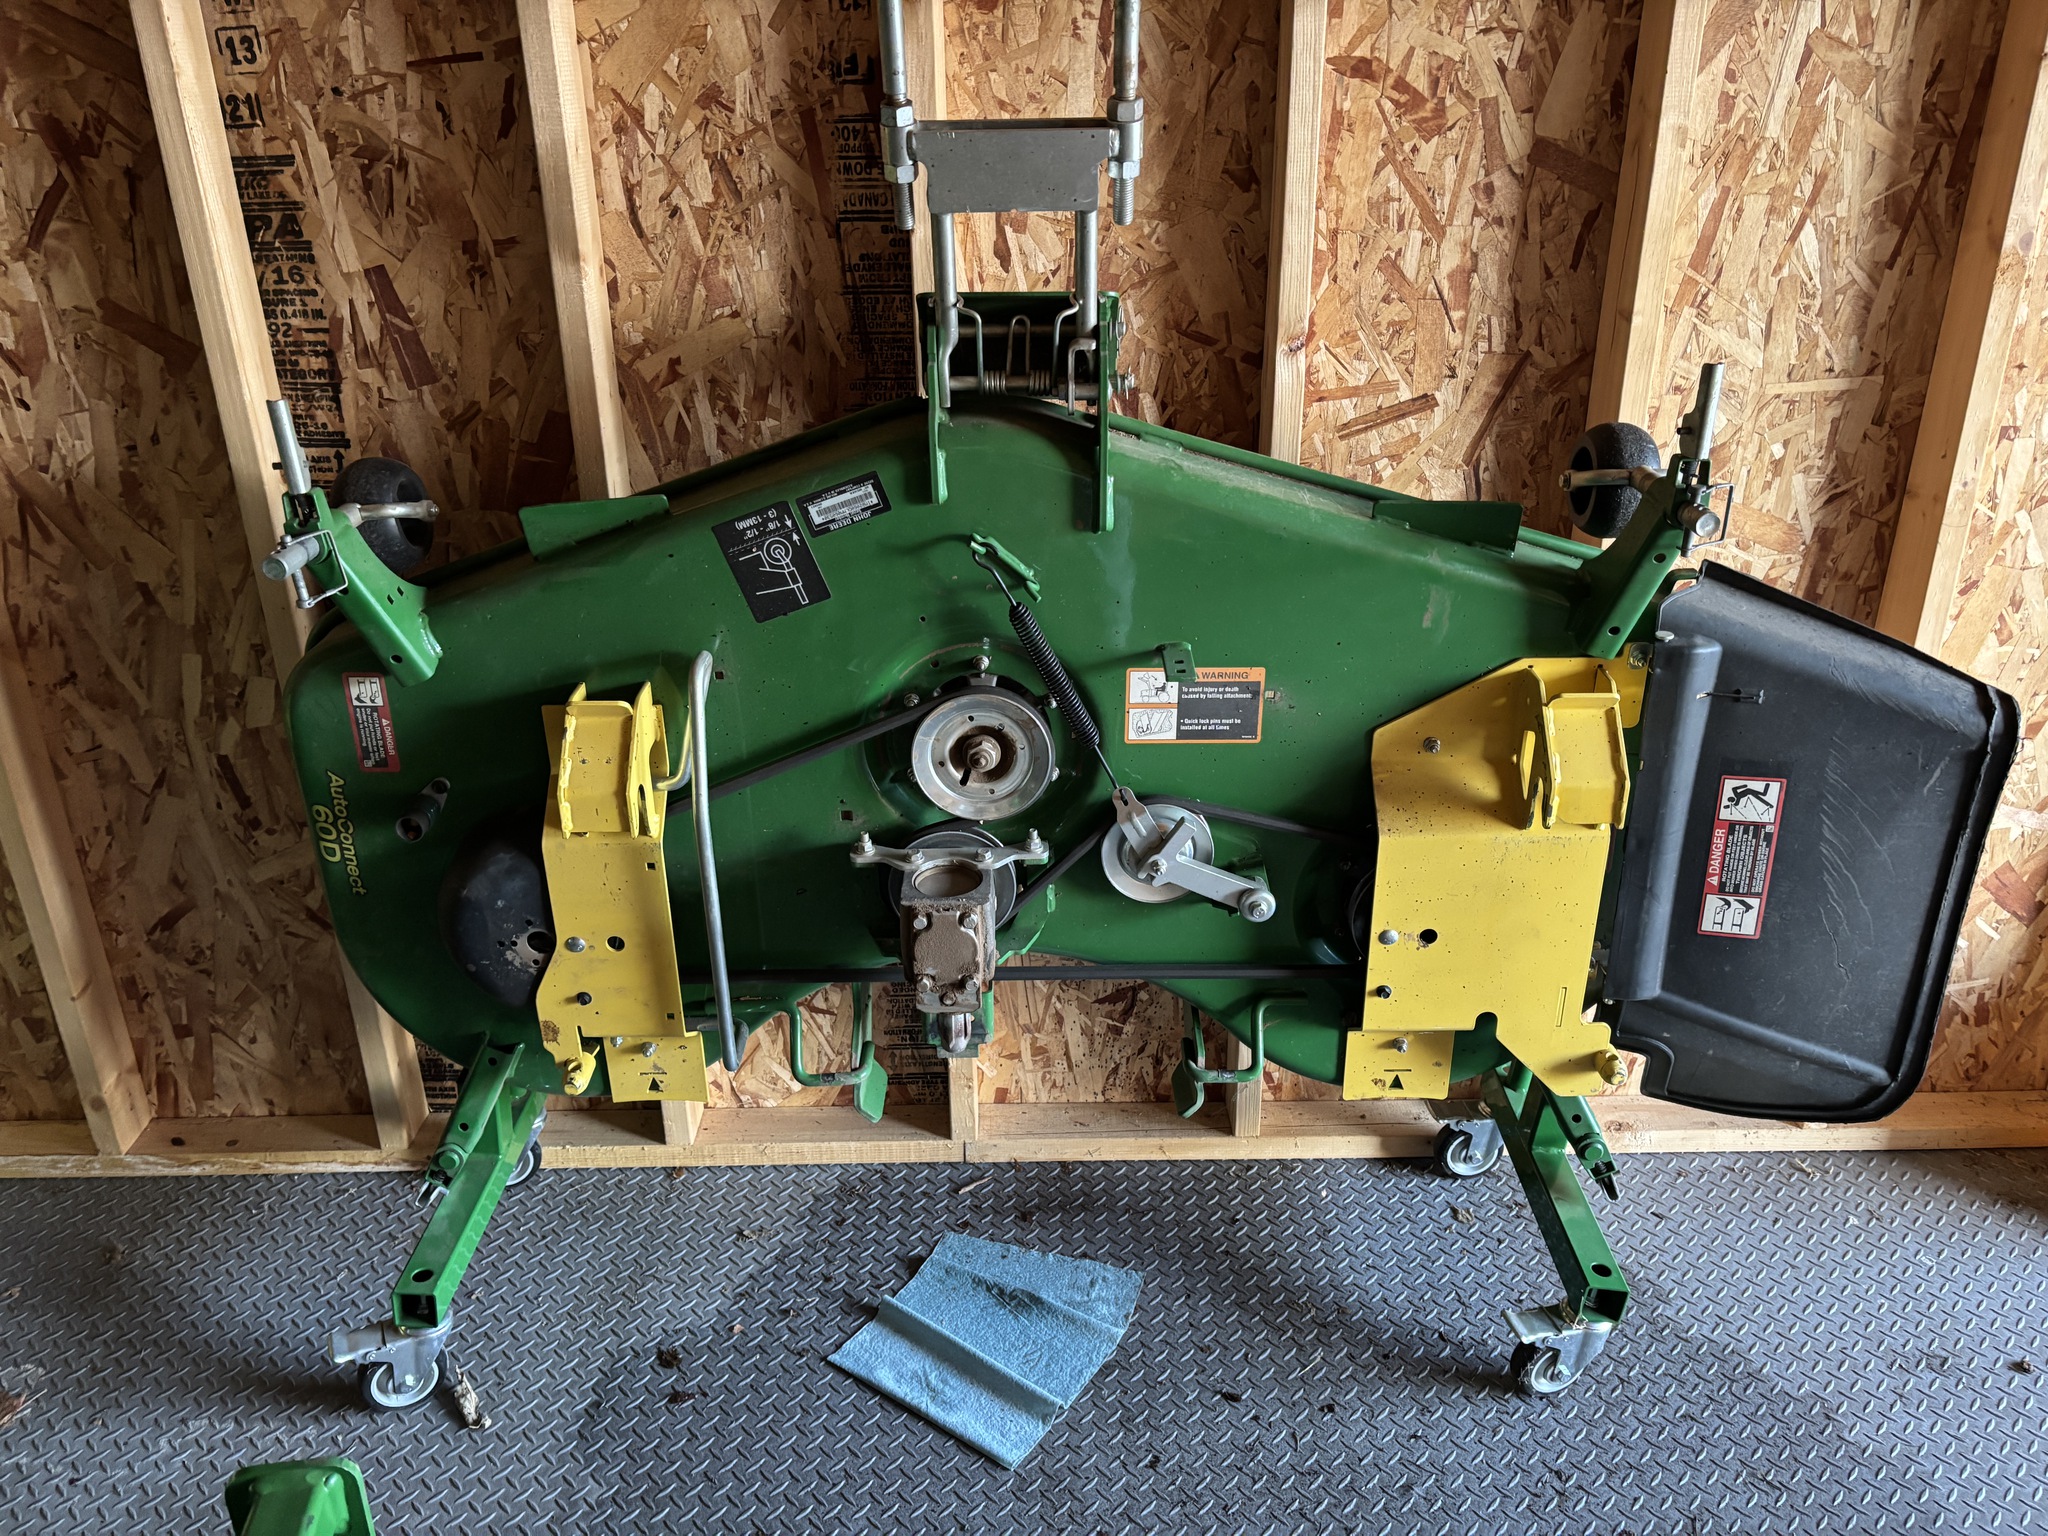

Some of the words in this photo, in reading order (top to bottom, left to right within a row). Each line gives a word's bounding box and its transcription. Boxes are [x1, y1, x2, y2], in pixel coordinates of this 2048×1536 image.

[225, 35, 257, 65] 13
[225, 92, 257, 122] 21
[843, 192, 888, 207] CANADA
[277, 369, 335, 380] ATEGORY
[828, 518, 852, 531] DEERE
[852, 511, 872, 522] JOHN
[1201, 671, 1249, 679] WARNING
[372, 712, 382, 740] ROTATING
[377, 740, 386, 759] BLADE
[383, 725, 396, 756] DANGER
[312, 804, 342, 863] 60D
[326, 770, 367, 896] AutoConnect
[1708, 828, 1726, 874] DANGER
[1735, 861, 1743, 884] THROWN
[1739, 834, 1748, 860] OBJECTS
[1721, 854, 1730, 882] ROTATING
